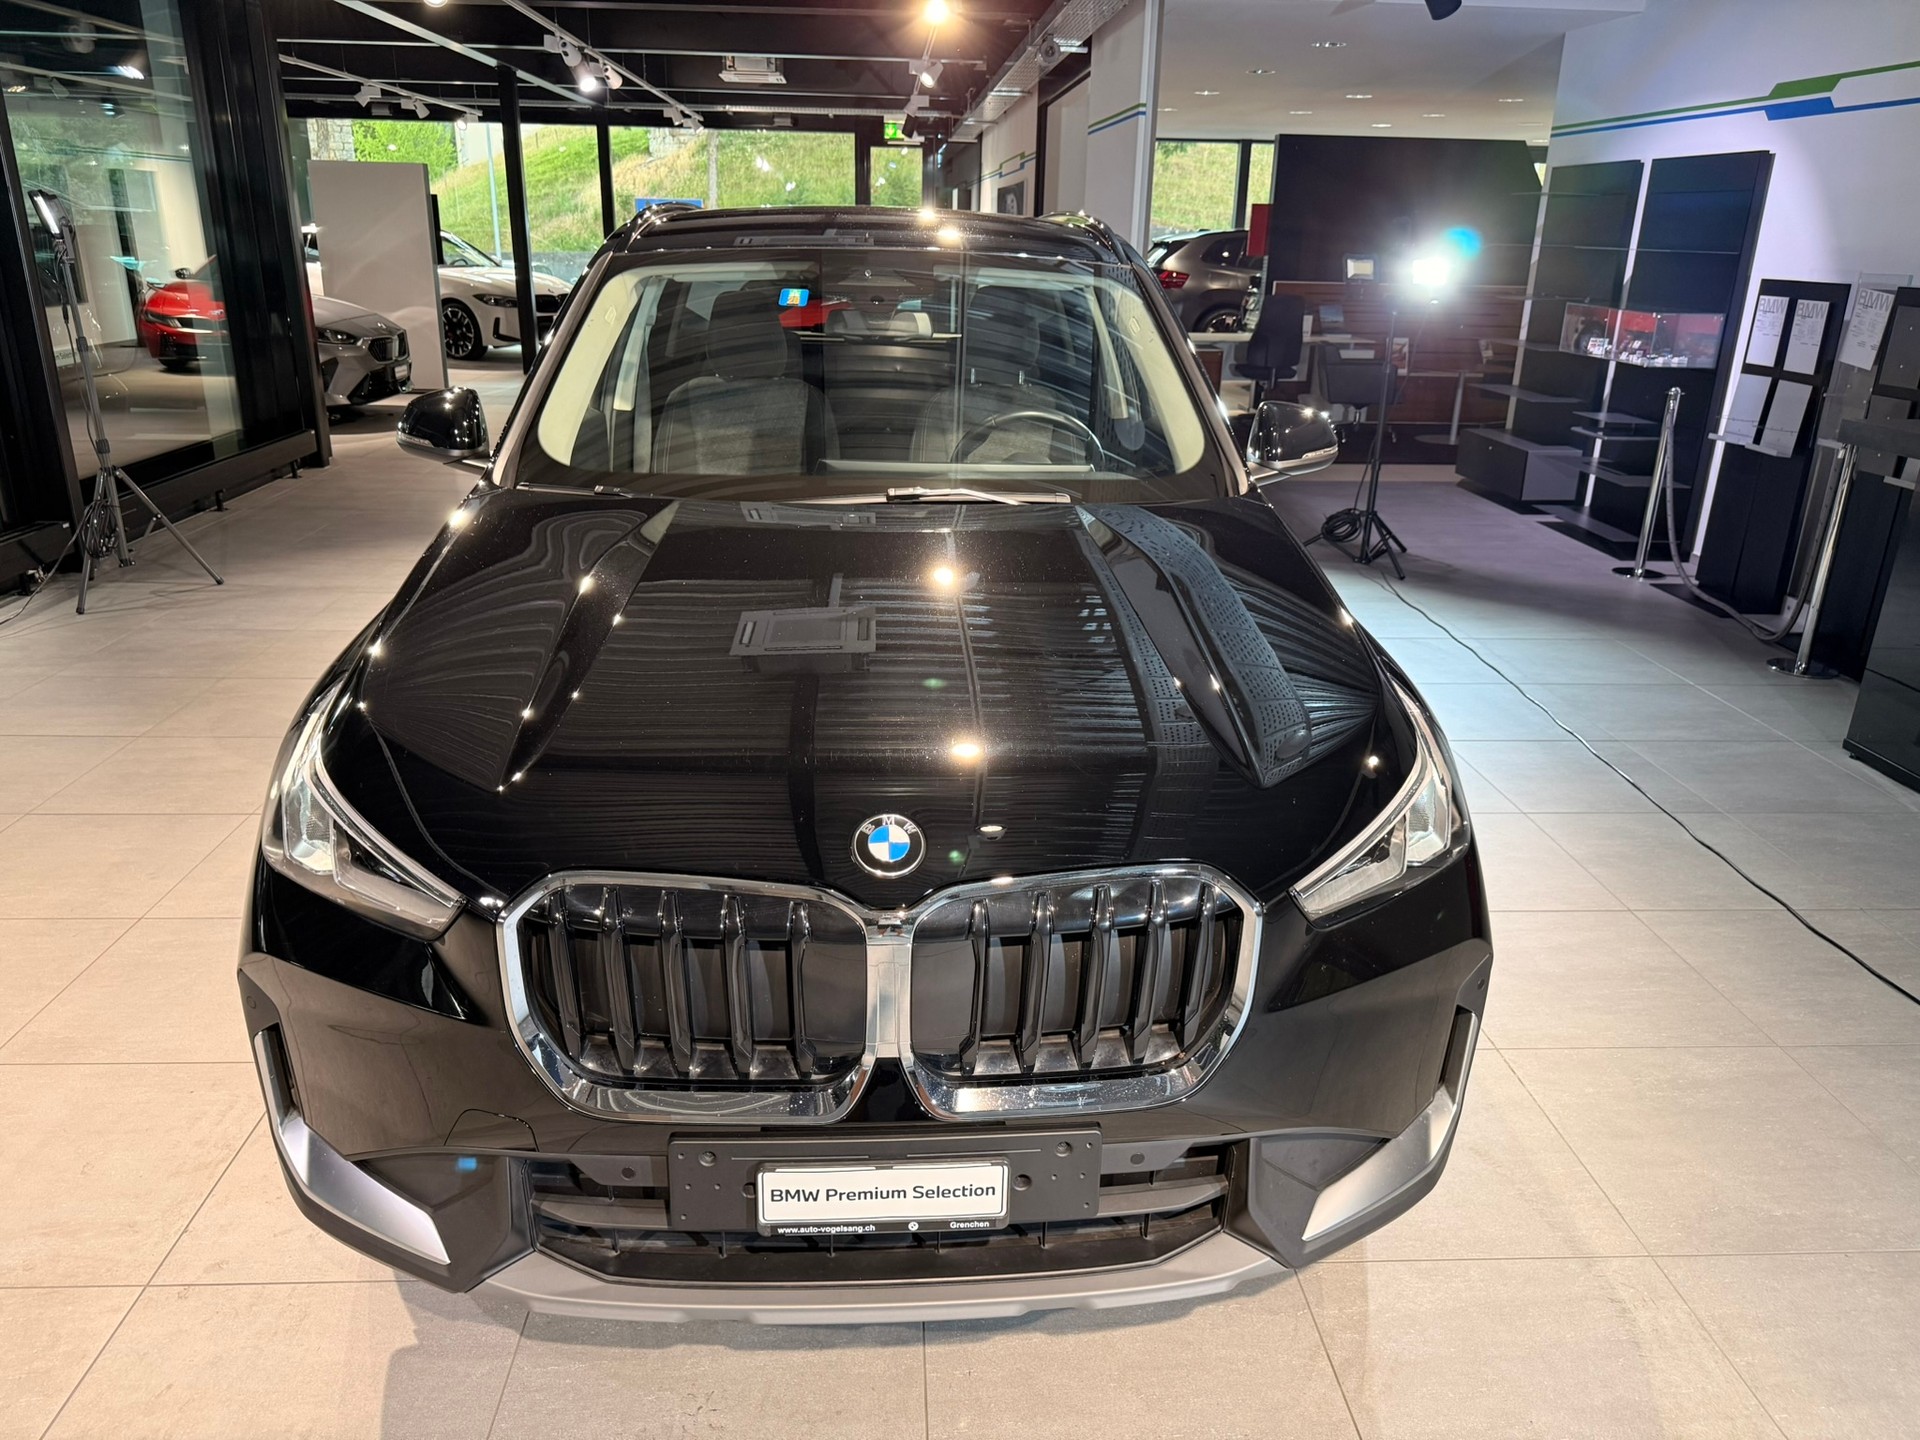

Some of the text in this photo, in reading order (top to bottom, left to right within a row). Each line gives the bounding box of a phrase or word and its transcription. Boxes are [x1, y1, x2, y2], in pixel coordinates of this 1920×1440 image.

[1759, 298, 1786, 314] BMW
[1796, 301, 1827, 319] BMW
[1858, 290, 1892, 312] BMW
[861, 816, 917, 835] BMW
[771, 1184, 996, 1202] BMW Premium Selection
[777, 1221, 990, 1235] www.auto-vogelsang.ch Grenchen
